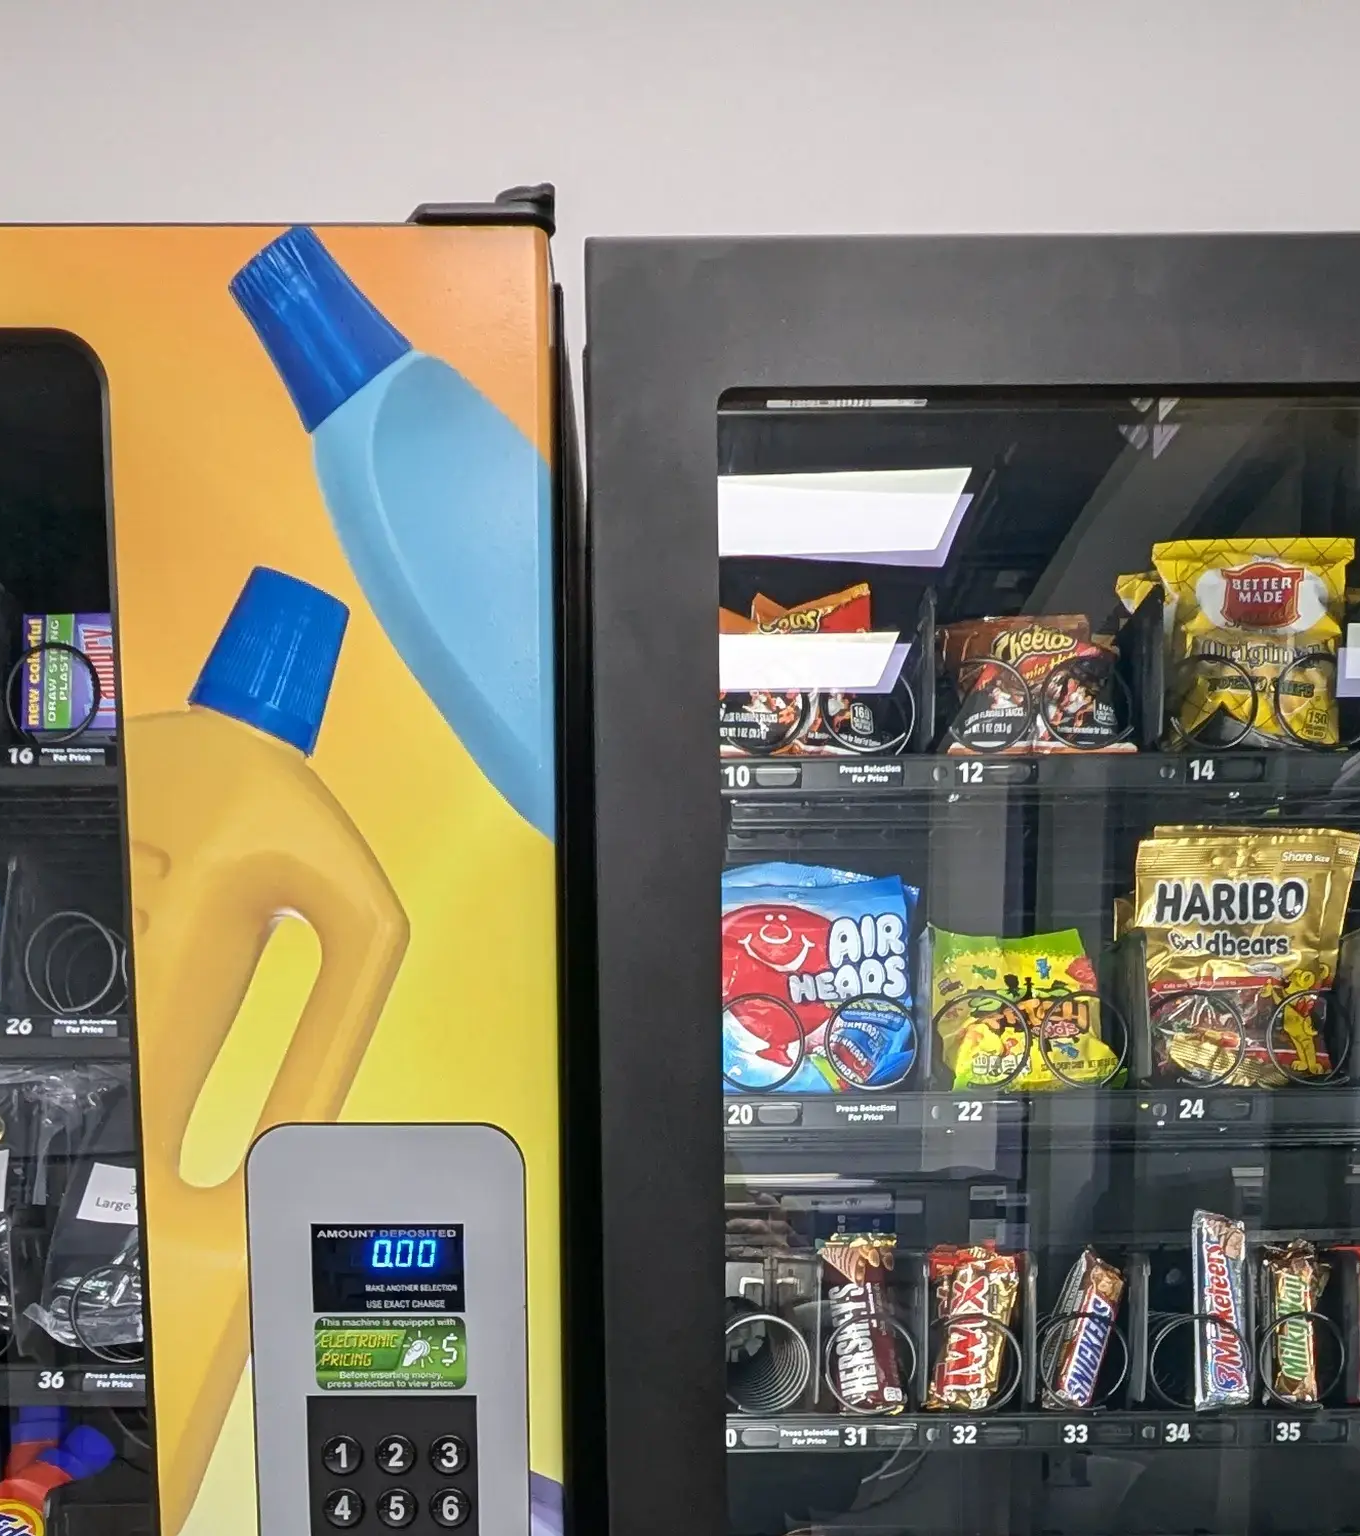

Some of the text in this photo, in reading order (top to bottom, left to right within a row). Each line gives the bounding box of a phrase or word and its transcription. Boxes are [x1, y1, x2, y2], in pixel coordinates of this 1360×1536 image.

[1233, 577, 1291, 591] BETTER
[1239, 590, 1282, 603] MADE
[993, 625, 1075, 665] Cheetos
[28, 689, 39, 725] new
[9, 749, 33, 764] 16
[724, 766, 750, 786] 10
[959, 762, 983, 782] 12
[1190, 759, 1214, 780] 14
[1281, 852, 1312, 862] Share
[1155, 879, 1306, 924] HARIBO
[829, 914, 905, 967] AIR
[789, 956, 907, 1003] HEADS
[6, 1019, 32, 1034] 26
[728, 1105, 753, 1124] 20
[958, 1102, 983, 1121] 22
[1179, 1100, 1205, 1118] 24
[95, 1197, 130, 1212] Large
[317, 1230, 375, 1238] AMOUNT
[372, 1239, 437, 1267] 0.00
[366, 1300, 445, 1308] USE EXACT CHANGE
[322, 1318, 340, 1326] This
[343, 1318, 380, 1326] machine
[382, 1318, 389, 1326] is
[393, 1318, 435, 1327] equipped
[320, 1335, 398, 1348] ELECTRONIC
[321, 1353, 371, 1366] PRICING
[1065, 1295, 1113, 1407] SNICKERS
[38, 1371, 64, 1389] 36
[371, 1372, 409, 1380] inserting
[844, 1429, 867, 1445] 31
[953, 1427, 976, 1444] 32
[1064, 1425, 1088, 1443] 33
[1166, 1424, 1190, 1442] 34
[1276, 1424, 1300, 1441] 35
[335, 1443, 458, 1467] 1 2 3
[334, 1496, 459, 1520] 4 5 6
